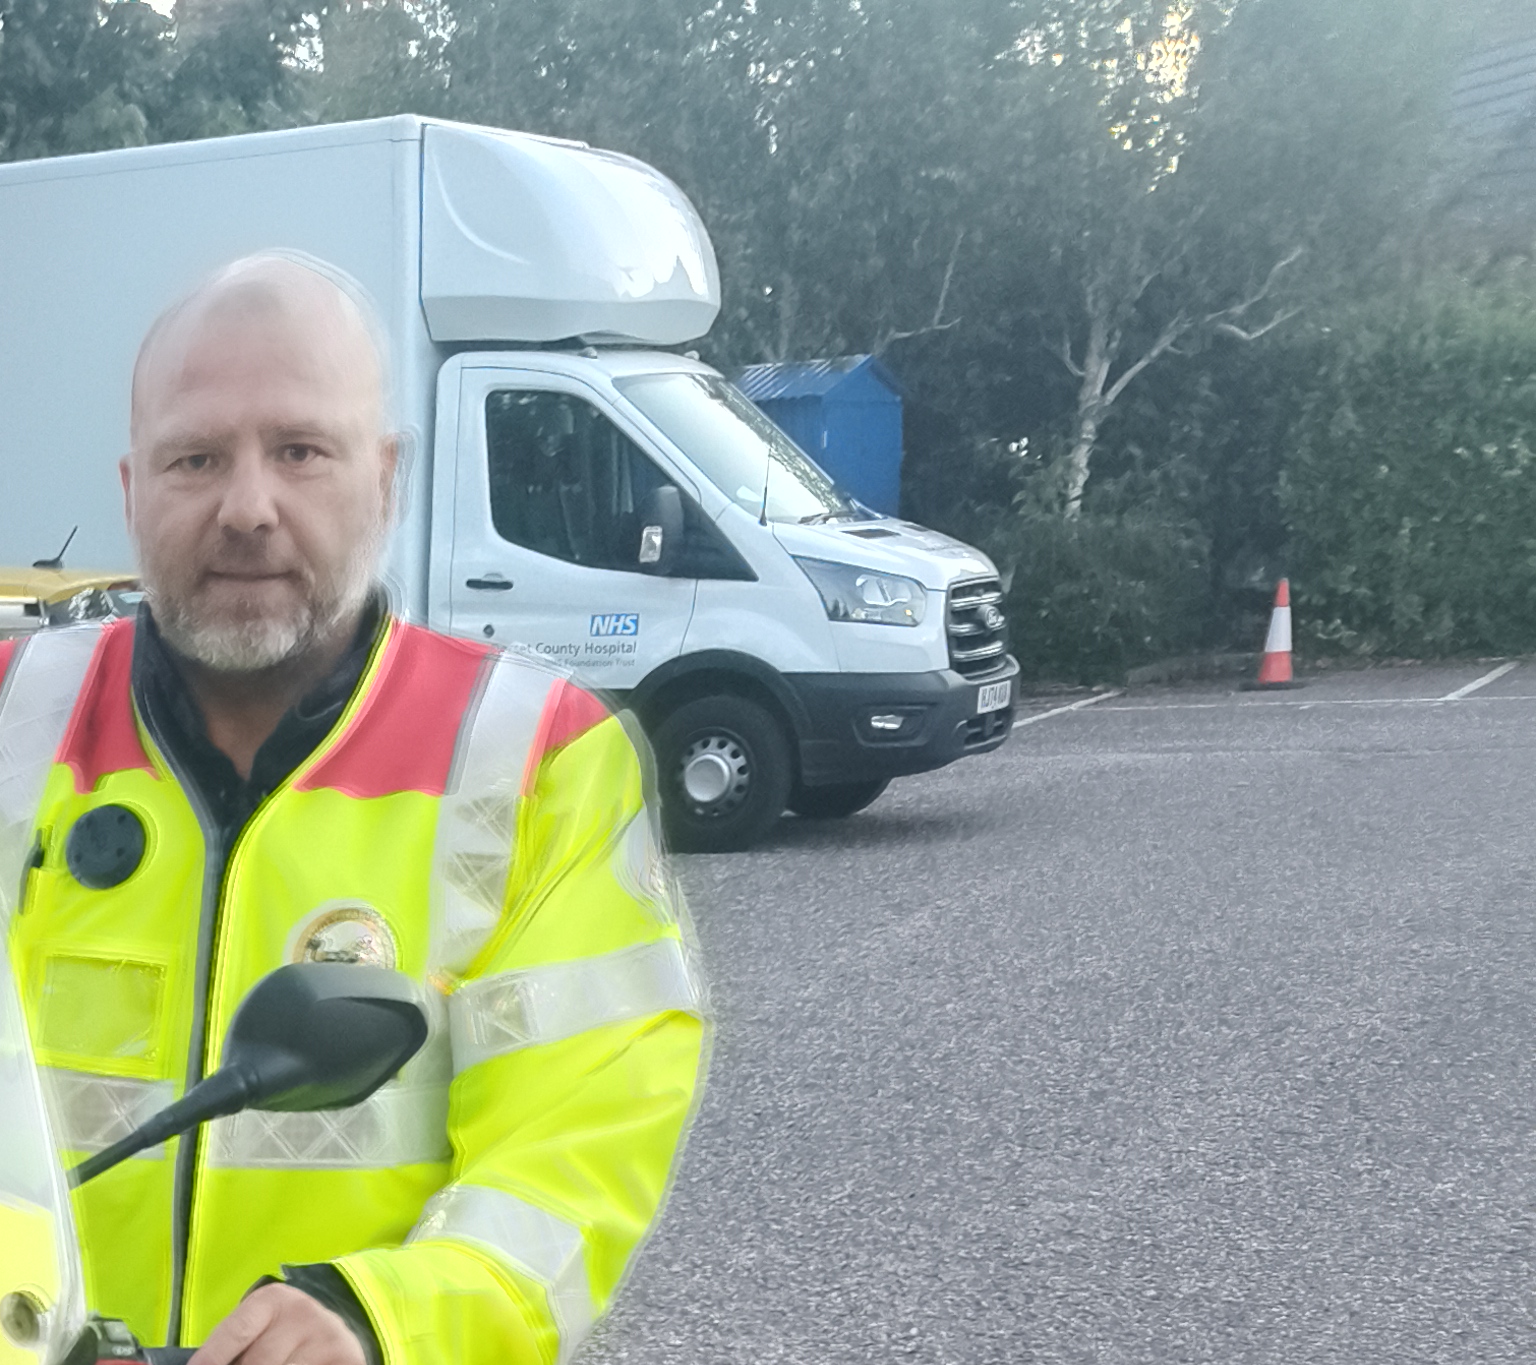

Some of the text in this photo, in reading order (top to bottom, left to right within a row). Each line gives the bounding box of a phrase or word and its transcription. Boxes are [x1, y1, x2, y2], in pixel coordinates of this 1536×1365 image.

[591, 614, 638, 636] NHS
[536, 642, 581, 657] County
[585, 641, 637, 657] Hospital
